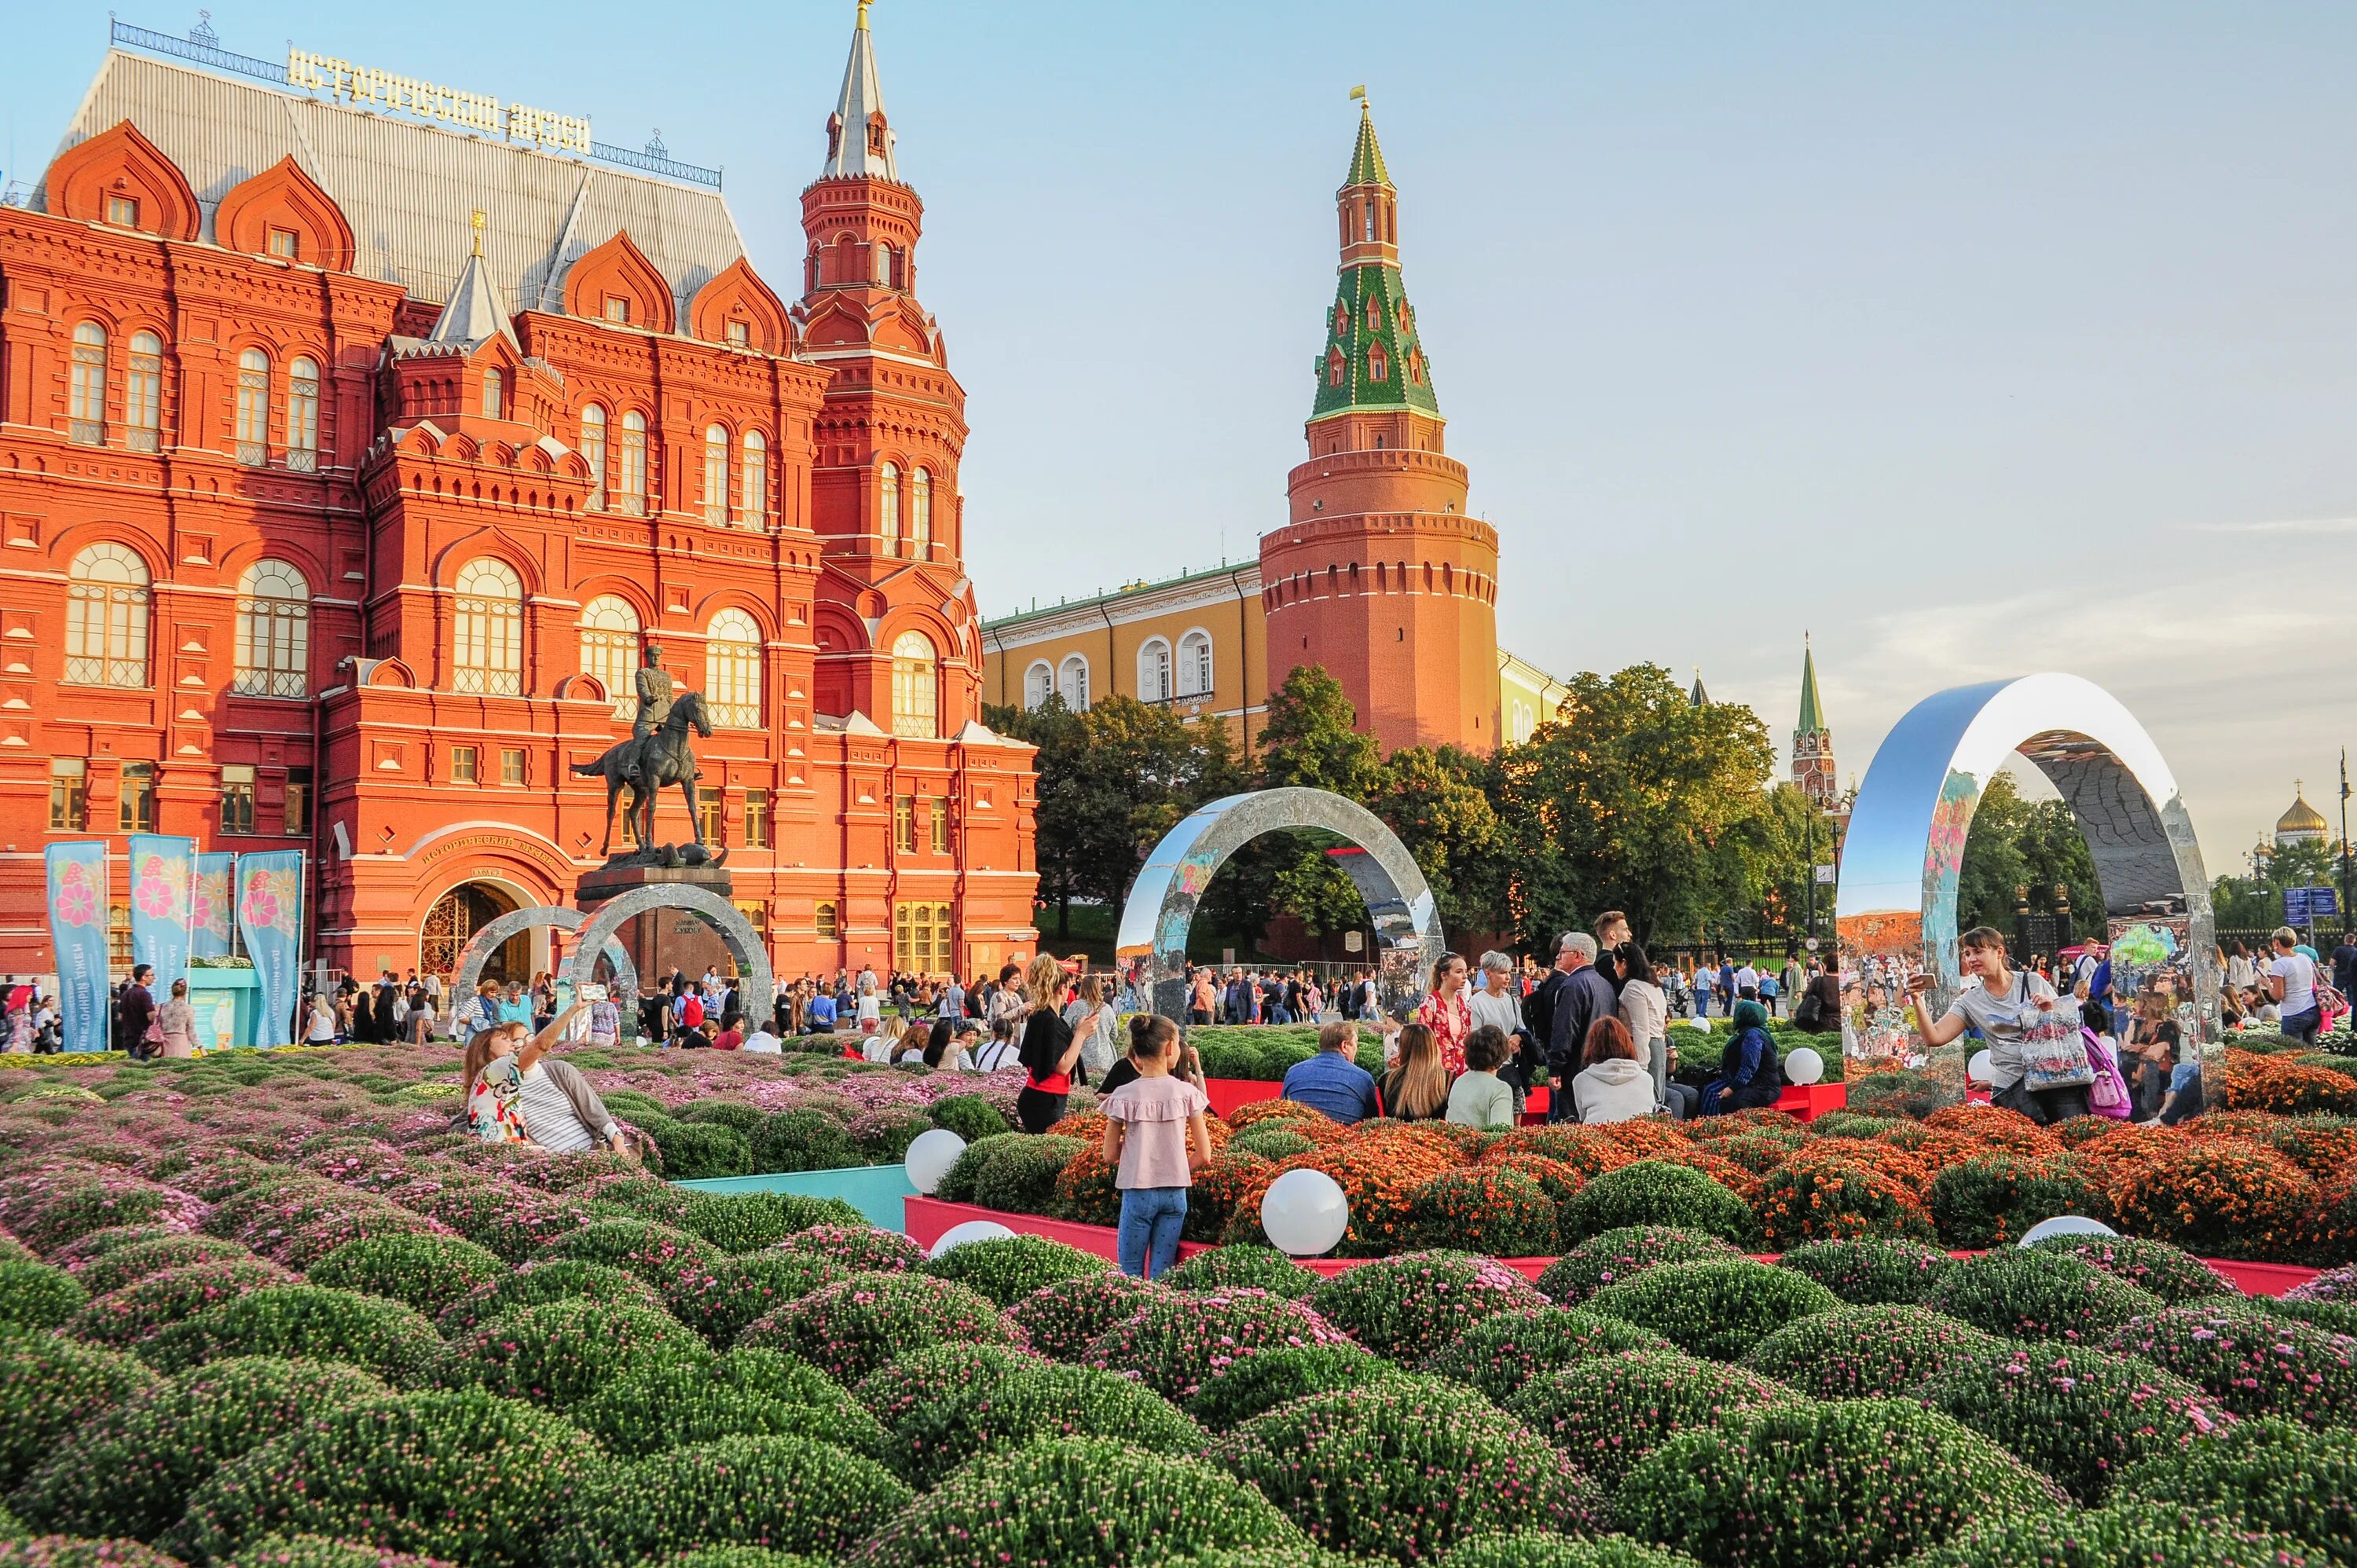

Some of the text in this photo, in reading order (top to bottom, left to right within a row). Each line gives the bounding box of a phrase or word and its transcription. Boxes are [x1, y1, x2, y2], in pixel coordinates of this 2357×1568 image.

[288, 47, 591, 156] ИСТОРИЧЕСКИЙ МУЗЕЙ
[421, 836, 555, 866] ИСТОРИЧЕСКИЙ МУЗЕЙ
